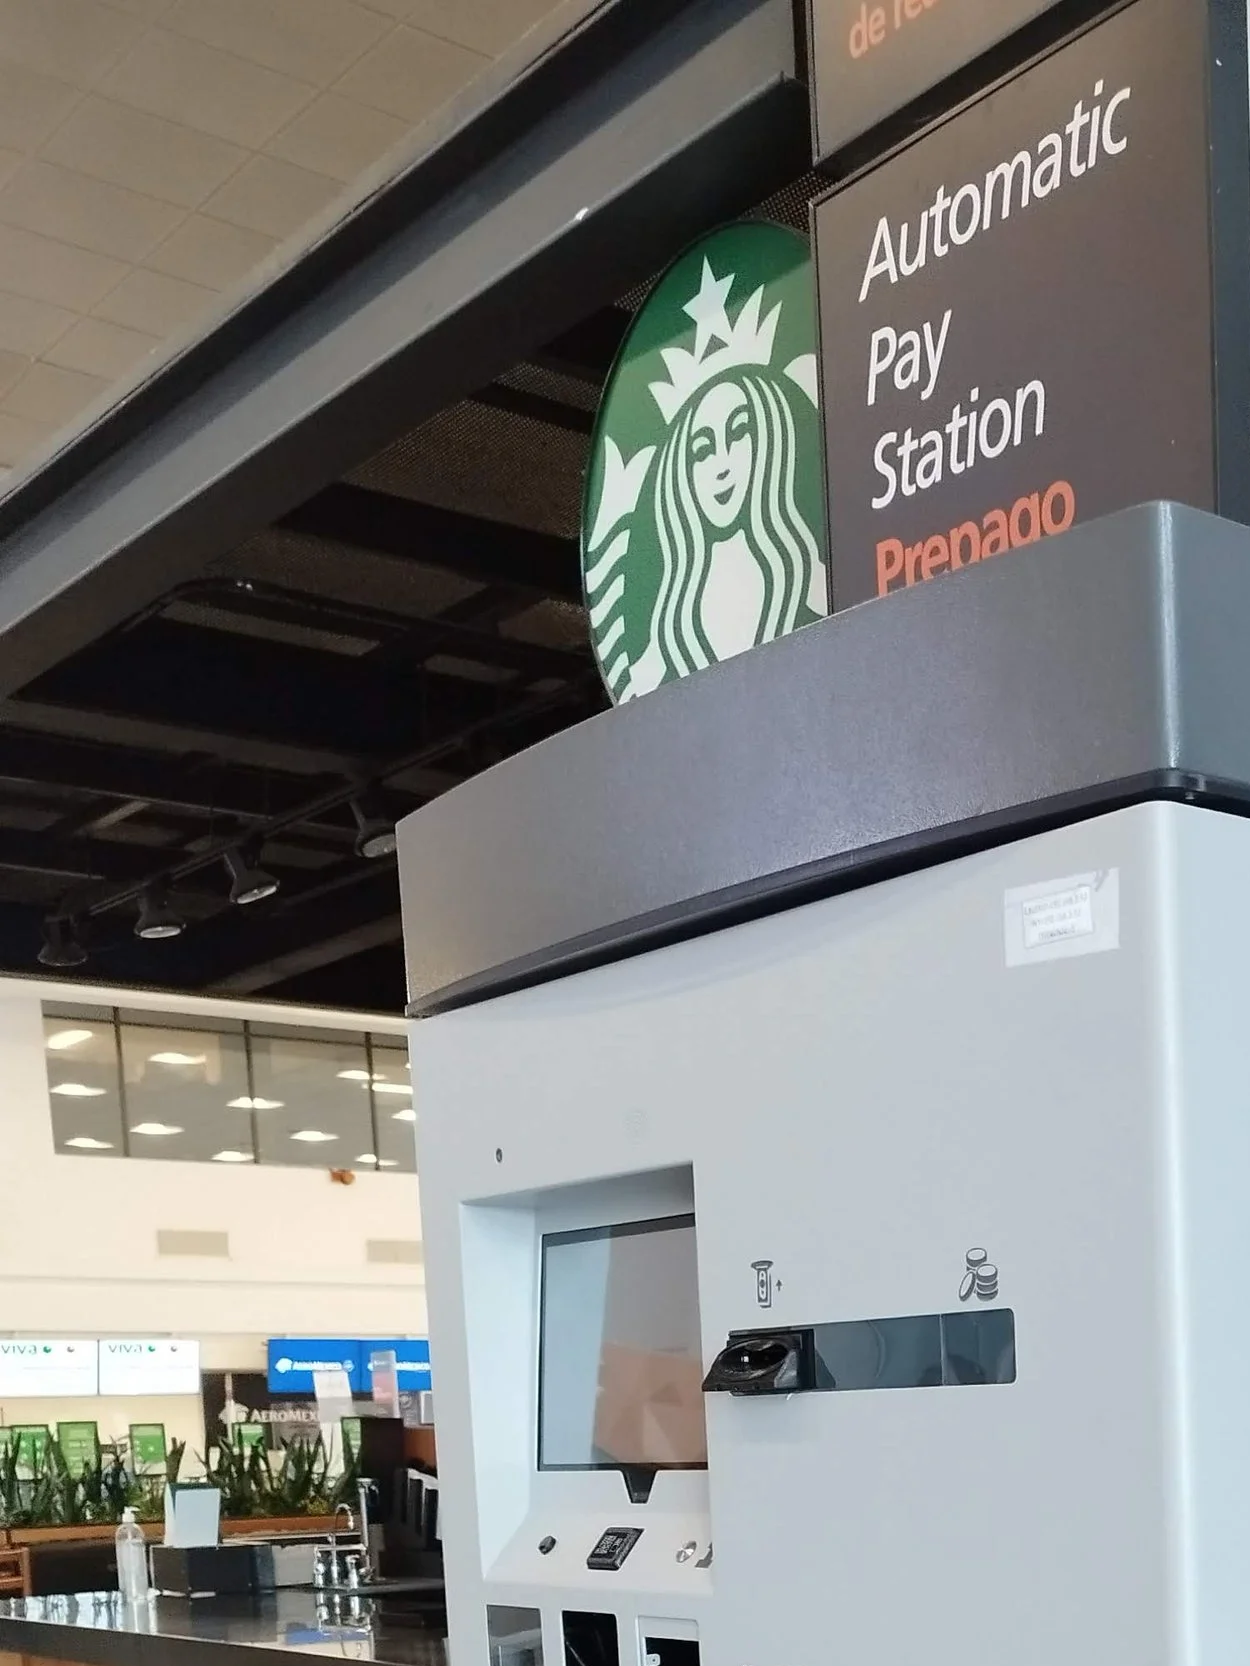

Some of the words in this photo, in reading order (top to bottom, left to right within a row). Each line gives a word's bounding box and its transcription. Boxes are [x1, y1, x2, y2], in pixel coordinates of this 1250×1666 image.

[849, 2, 887, 59] de
[858, 79, 1131, 302] Automatic
[867, 309, 952, 406] Pay
[871, 378, 1046, 510] Station
[251, 1408, 320, 1423] AEROMEX
